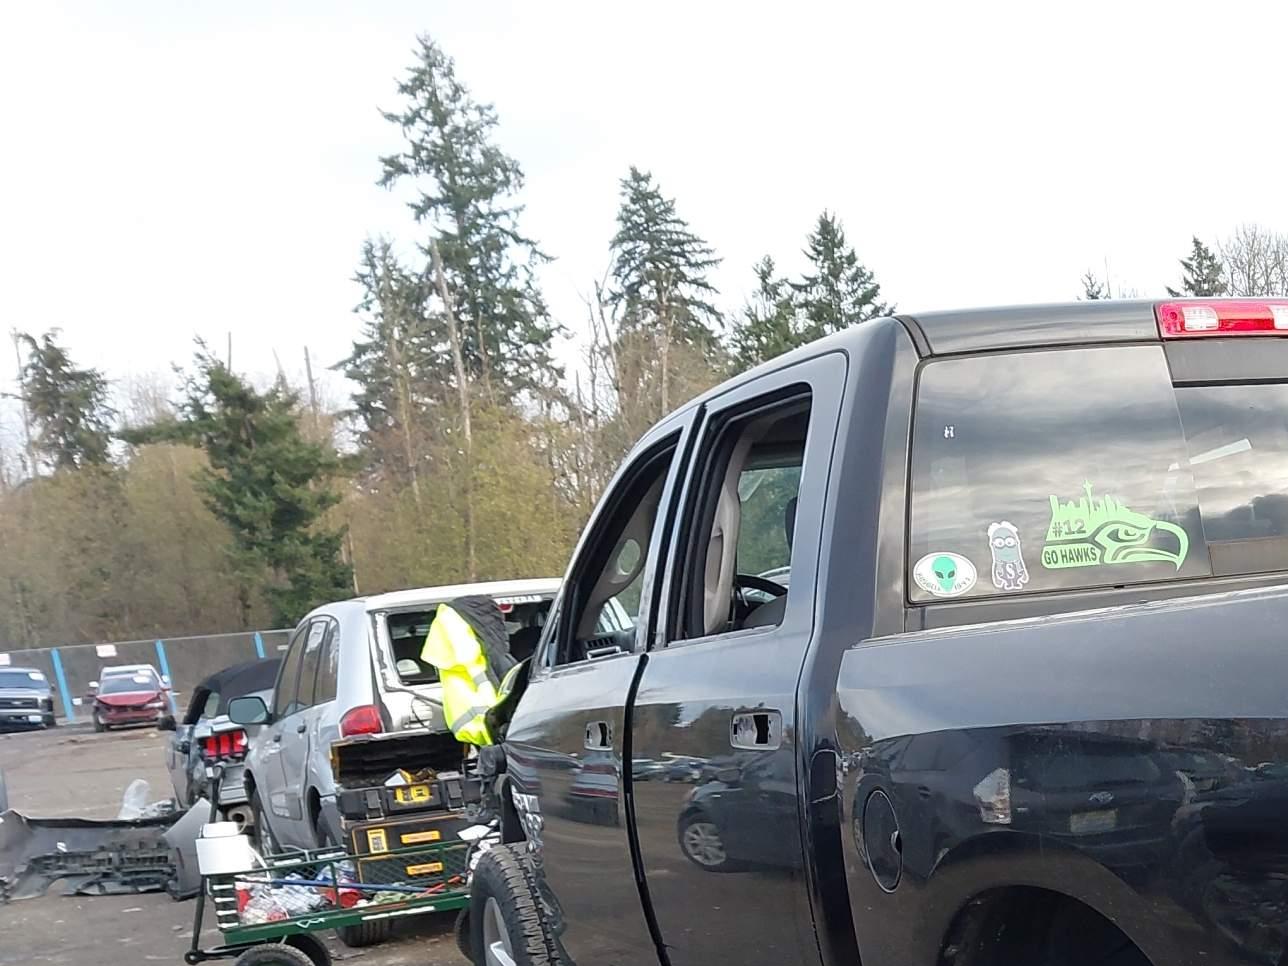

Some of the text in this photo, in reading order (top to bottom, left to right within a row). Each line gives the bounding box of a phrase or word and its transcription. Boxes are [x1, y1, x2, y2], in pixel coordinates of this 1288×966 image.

[1052, 517, 1087, 538] #12
[1044, 546, 1097, 565] GO HAWKS
